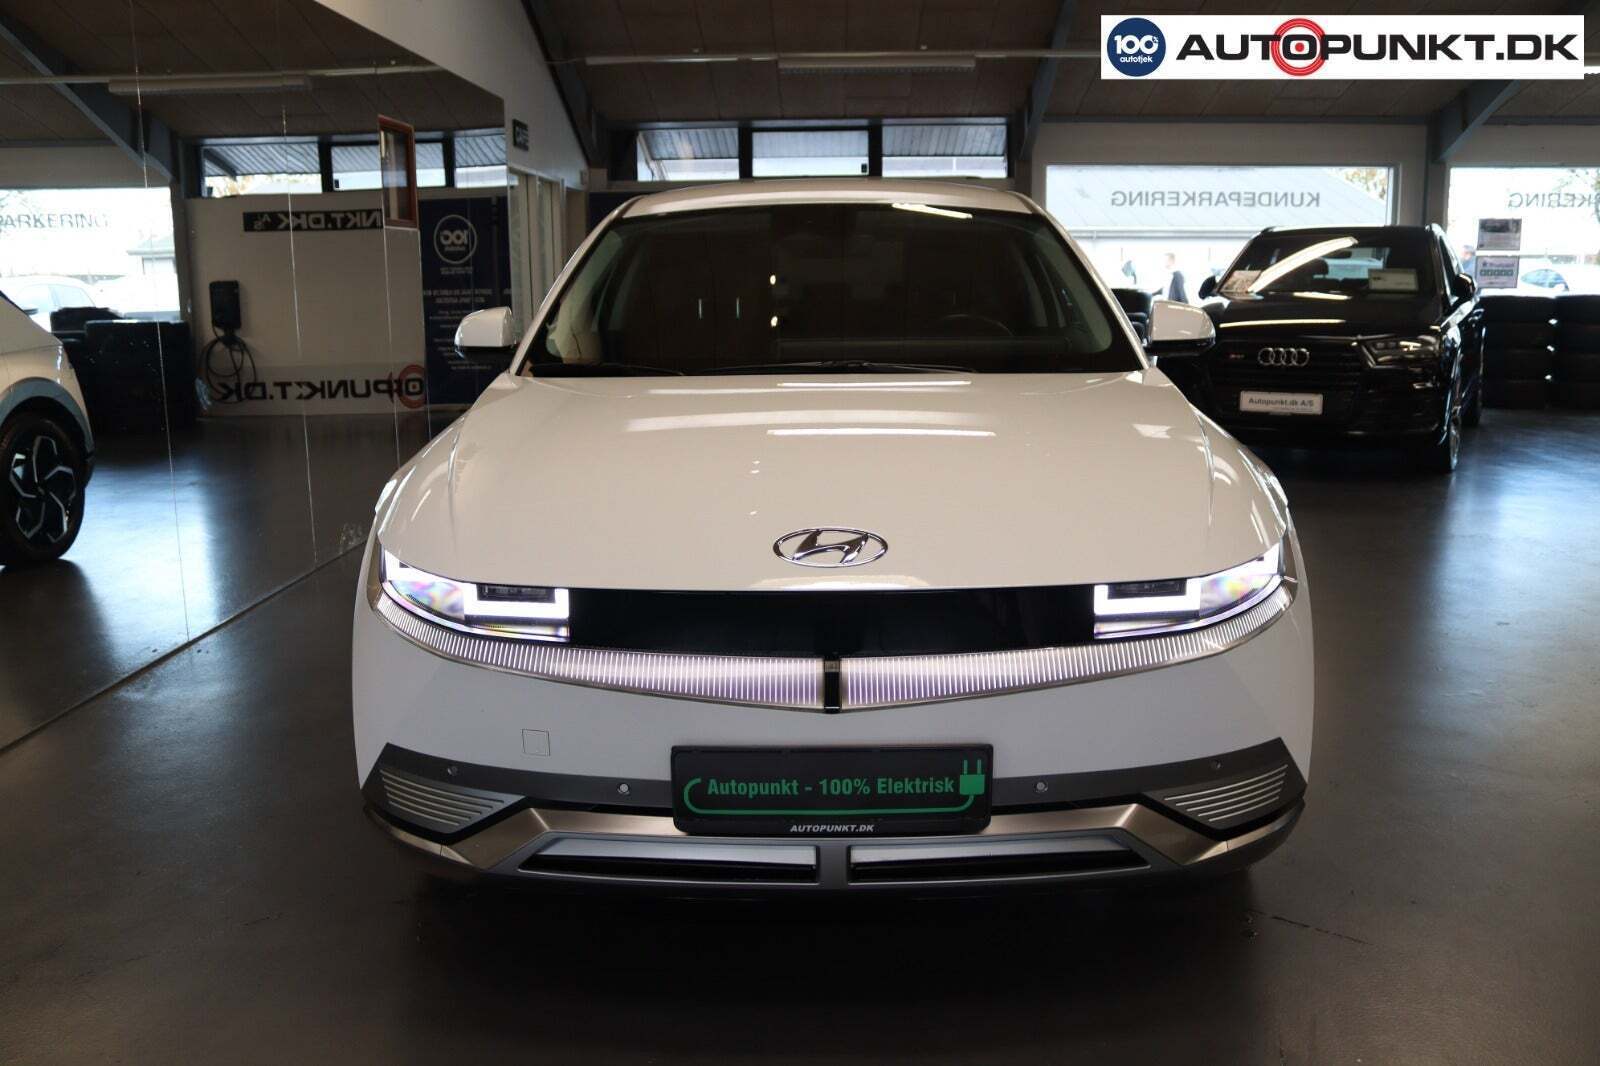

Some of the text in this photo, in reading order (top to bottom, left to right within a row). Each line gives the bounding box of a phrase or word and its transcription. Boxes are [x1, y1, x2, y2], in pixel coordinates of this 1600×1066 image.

[707, 778, 799, 798] Autopunkt
[819, 778, 871, 796] 100%
[877, 777, 955, 795] Elektrisk
[790, 824, 875, 833] AUTOPUNKT.DK
